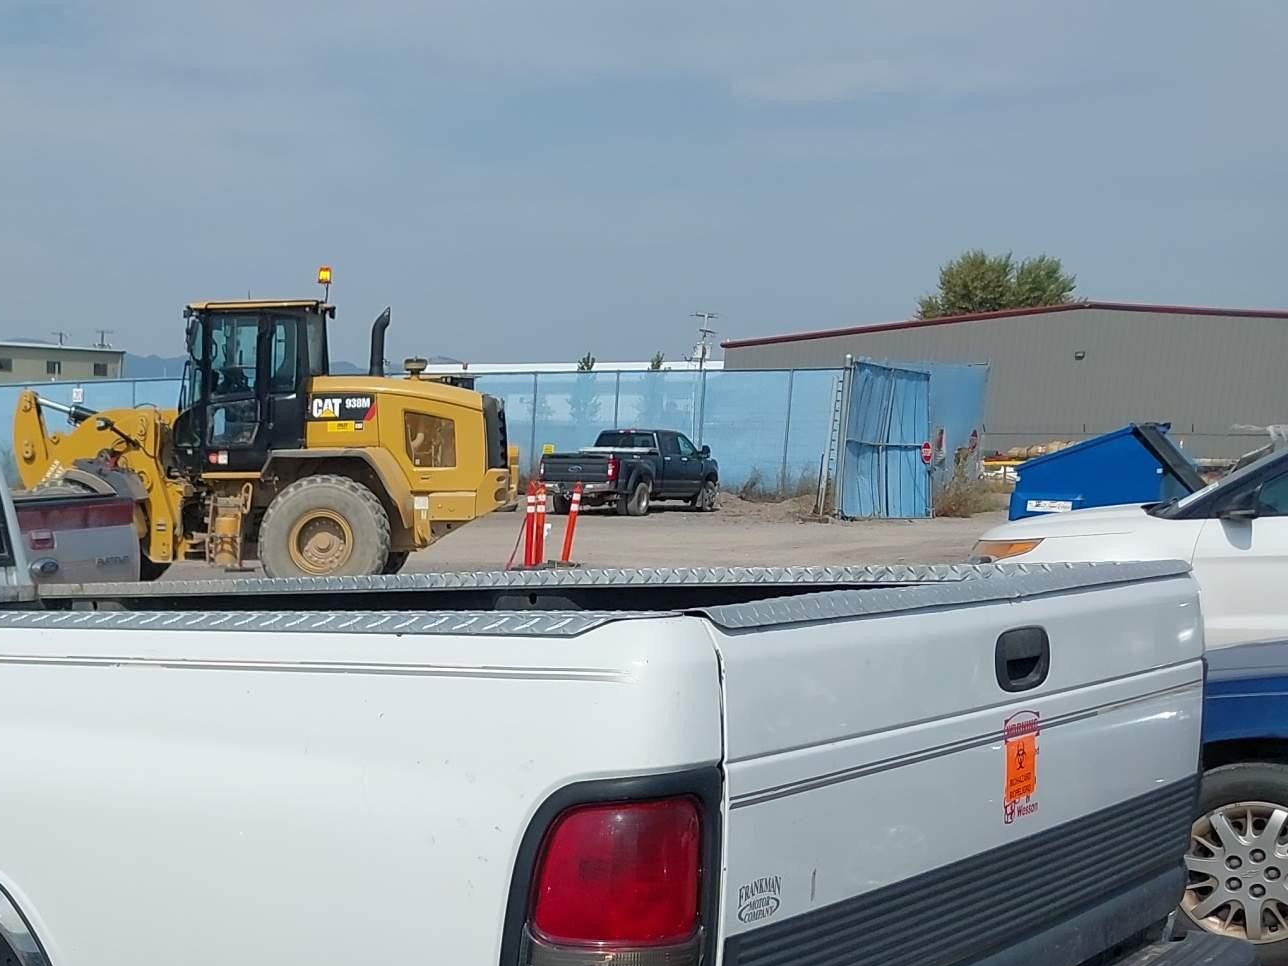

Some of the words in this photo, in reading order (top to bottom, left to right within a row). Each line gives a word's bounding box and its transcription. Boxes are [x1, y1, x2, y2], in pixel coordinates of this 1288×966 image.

[312, 398, 342, 418] CAT
[345, 397, 371, 409] 938M
[738, 876, 782, 910] FRANKMAN
